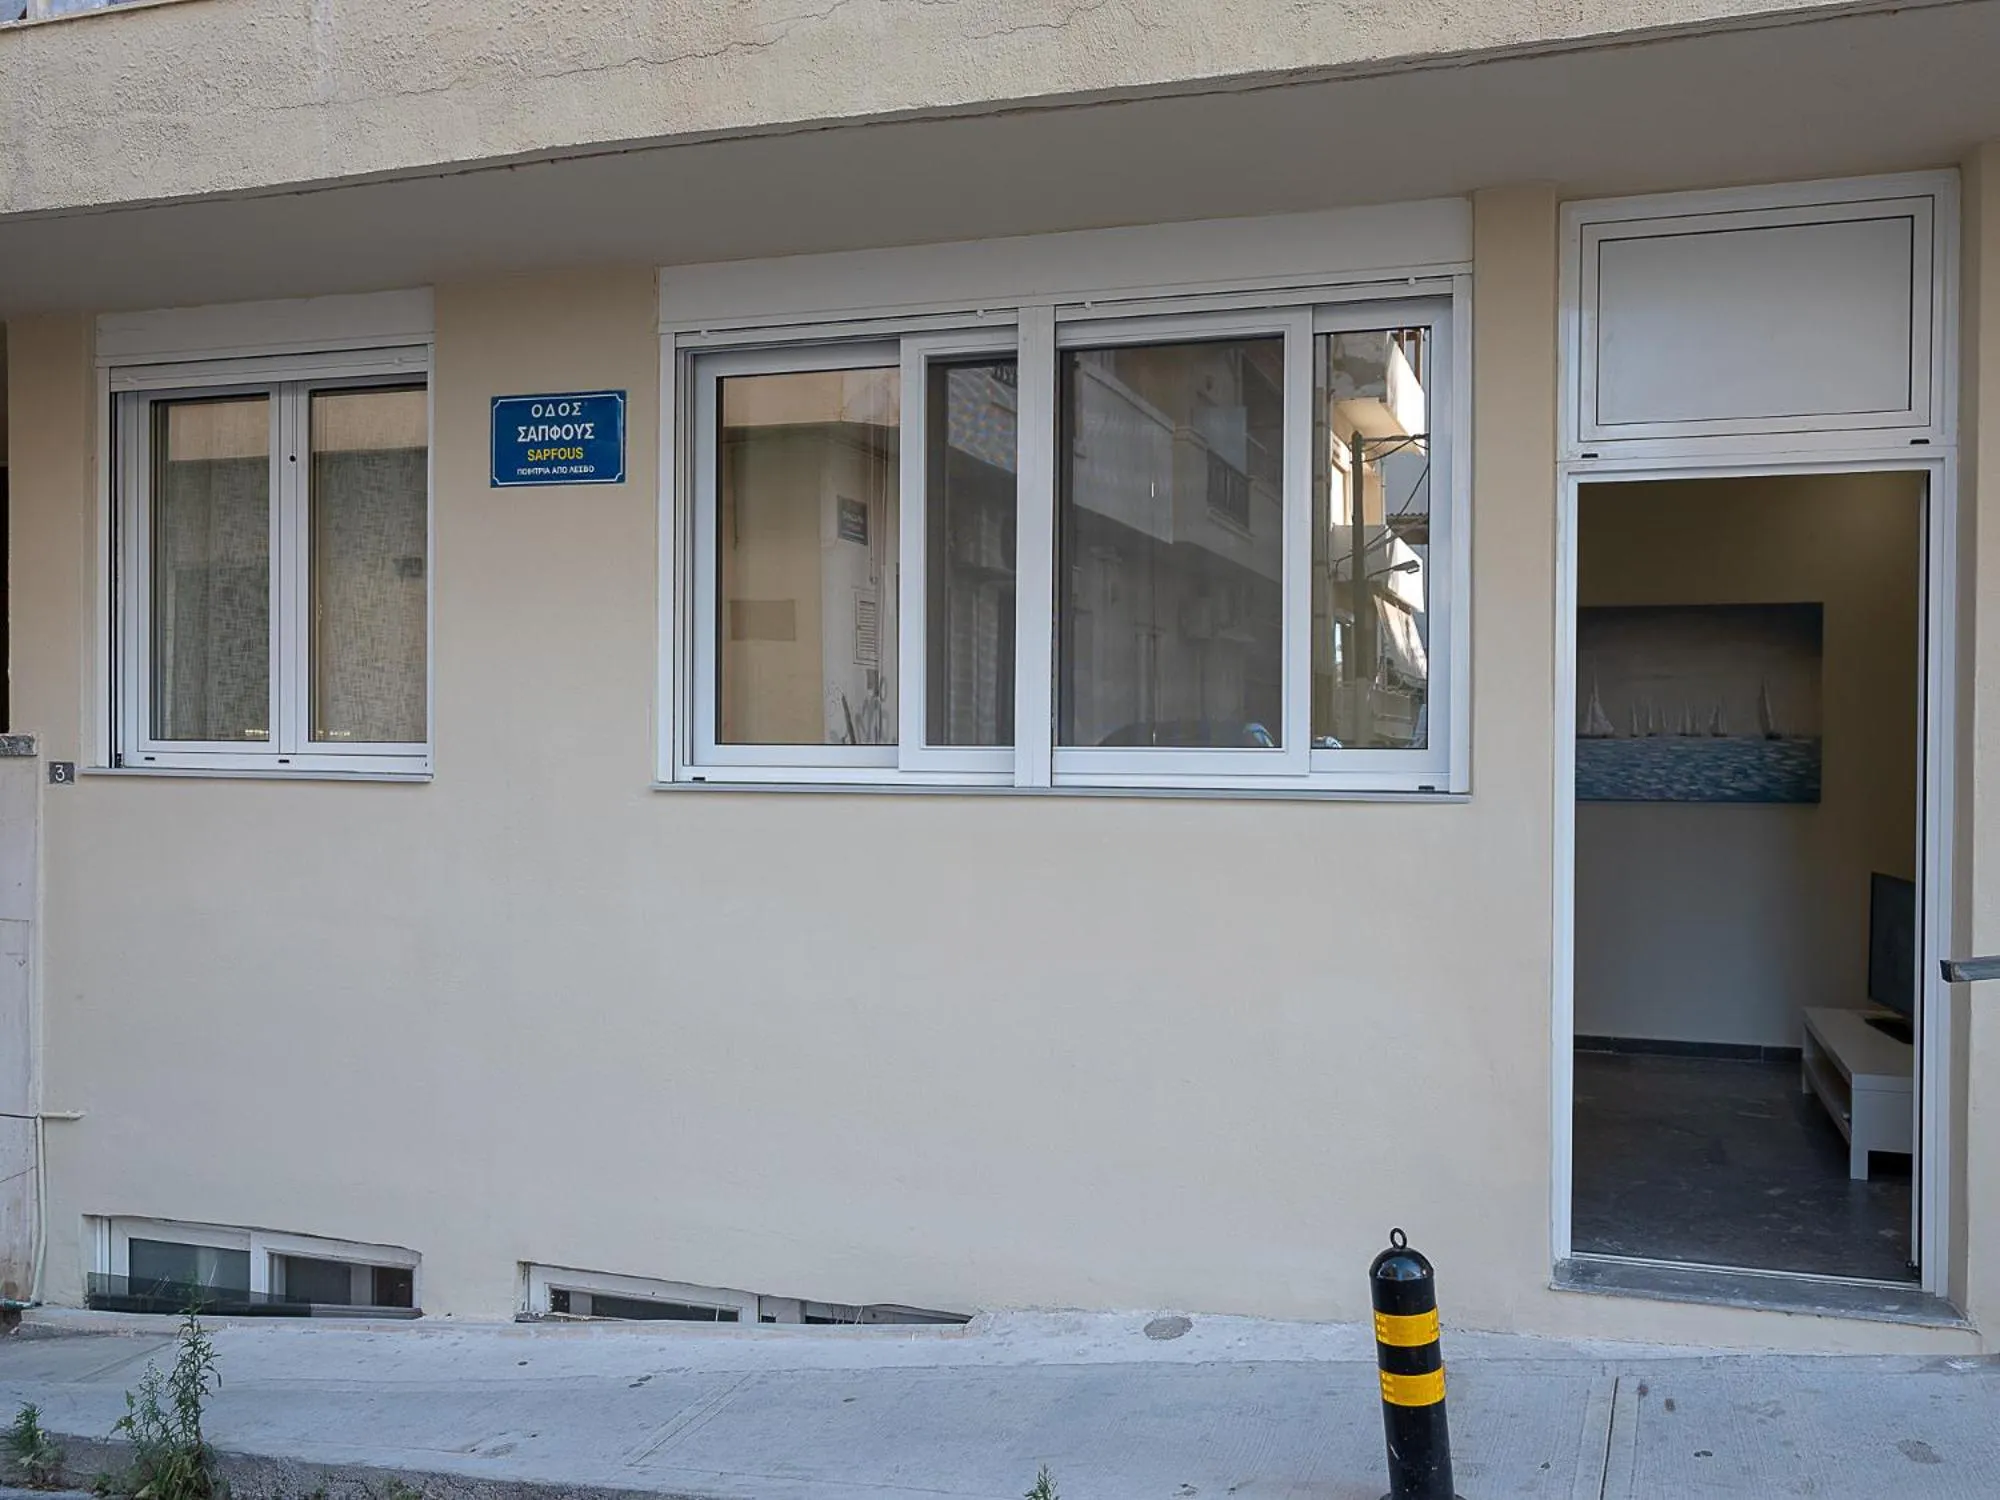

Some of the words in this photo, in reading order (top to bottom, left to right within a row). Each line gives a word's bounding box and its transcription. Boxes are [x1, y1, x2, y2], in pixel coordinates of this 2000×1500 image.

[531, 402, 582, 418] ΟΔΟΣ
[517, 423, 595, 442] ΣΑΠΦΟΥΣ
[527, 447, 584, 461] SAPFOUS
[552, 465, 568, 475] ΑΠΟ
[55, 764, 65, 781] 3
